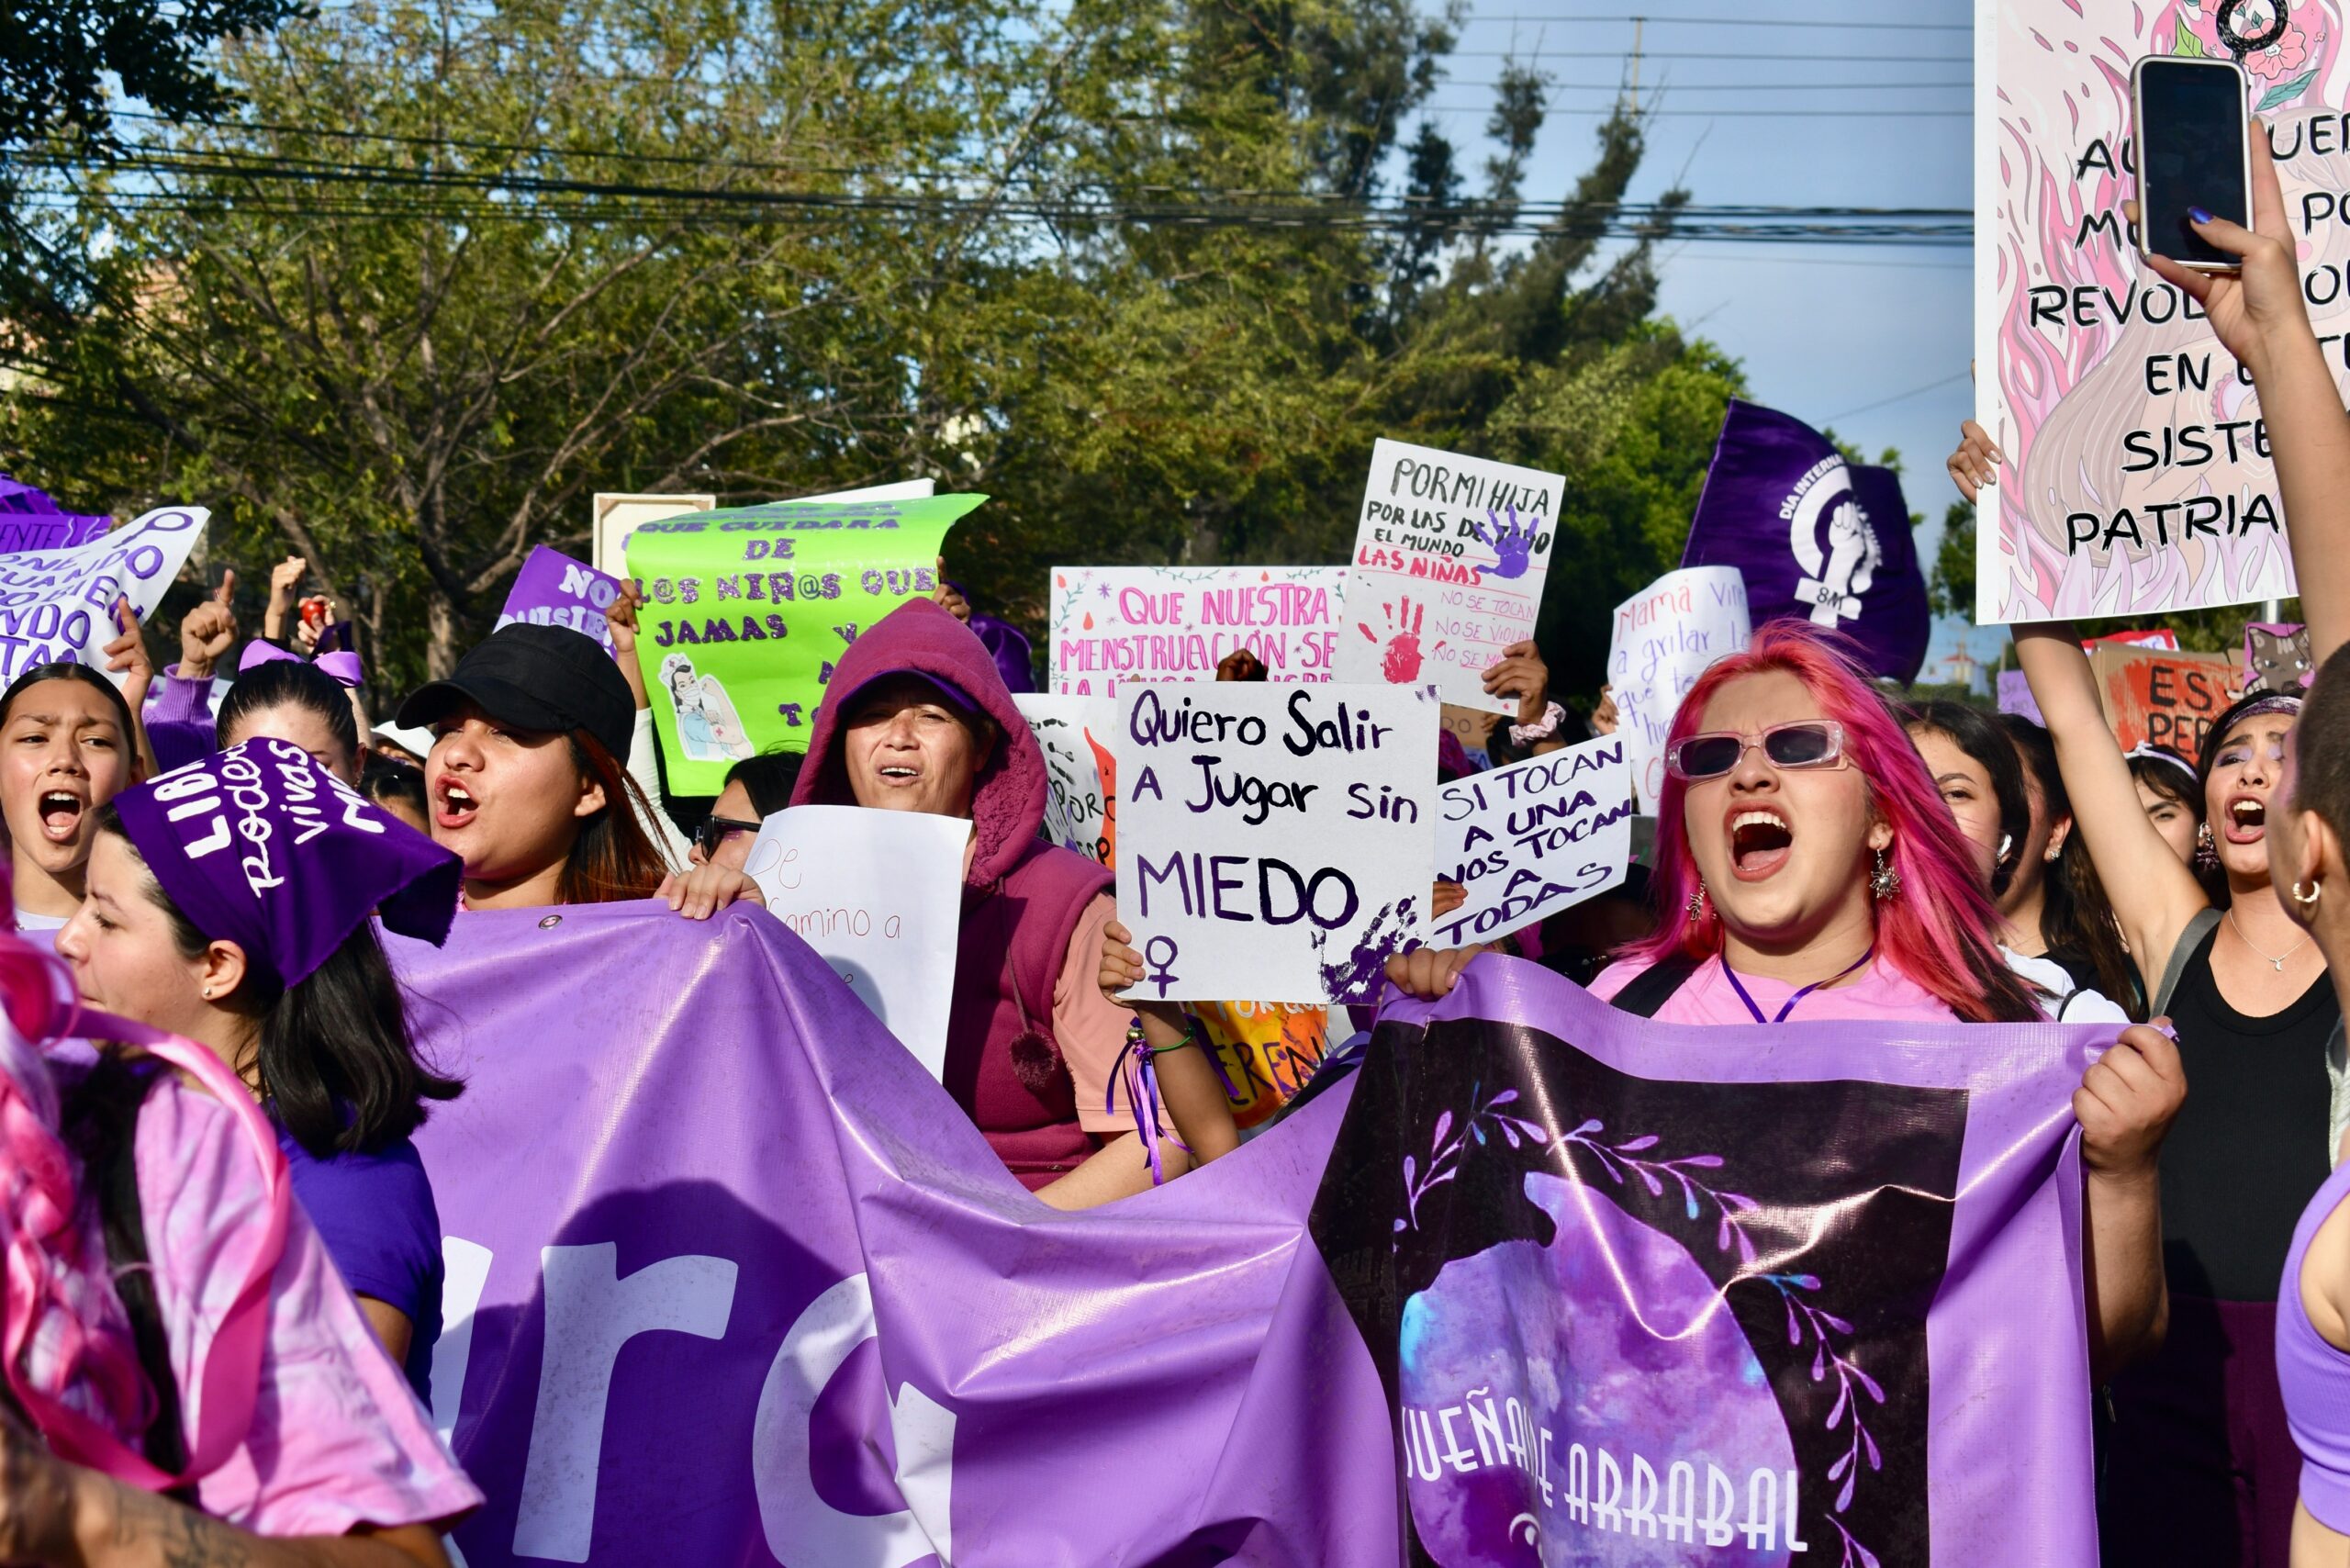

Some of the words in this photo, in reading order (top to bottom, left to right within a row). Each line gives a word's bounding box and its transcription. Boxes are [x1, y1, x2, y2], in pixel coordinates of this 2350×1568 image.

[2145, 353, 2210, 395] EN
[2121, 418, 2273, 472] SISTE
[1390, 458, 1449, 504] POR
[1449, 471, 1485, 509] MI
[1487, 478, 1549, 517] HIJA
[1366, 500, 1404, 525] POR
[1410, 509, 1447, 533] LAS
[1457, 517, 1485, 543] DE
[1374, 528, 1393, 543] EL
[1401, 532, 1464, 557] MUNDO
[2066, 494, 2280, 556] PATRIA
[742, 538, 797, 560] DE
[1358, 544, 1404, 571] LAS
[1409, 554, 1481, 586] NIÑAS
[860, 566, 936, 597] QUE
[1817, 586, 1843, 611] 8M
[1119, 587, 1184, 625] QUE
[1201, 583, 1330, 627] NUESTRA
[1441, 589, 1463, 606] NO
[1466, 596, 1486, 610] SE
[1492, 599, 1538, 619] TOCAN
[655, 613, 788, 647] JAMAS
[1436, 617, 1460, 636] NO
[1462, 622, 1483, 640] SE
[1489, 624, 1533, 642] VIOLAN
[1432, 646, 1456, 662] NO
[1460, 650, 1480, 667] SE
[1616, 650, 1628, 676] a
[2149, 665, 2213, 711] ES
[1130, 689, 1267, 747] Quiero
[1282, 689, 1393, 756] Salir
[268, 739, 330, 845] vivas
[1131, 765, 1163, 802] A
[1184, 755, 1319, 825] Jugar
[1441, 782, 1488, 821] SI
[1494, 740, 1623, 799] TOCAN
[1437, 850, 1509, 884] NOS
[1513, 798, 1631, 859] TOCAN
[1463, 824, 1494, 853] A
[1506, 790, 1597, 835] UNA
[1136, 850, 1360, 930] MIEDO
[1433, 861, 1613, 946] TODAS
[1503, 868, 1542, 898] A
[883, 913, 901, 939] a
[1401, 1386, 1537, 1482] UEÑA
[1563, 1442, 1808, 1553] ARRABAL
